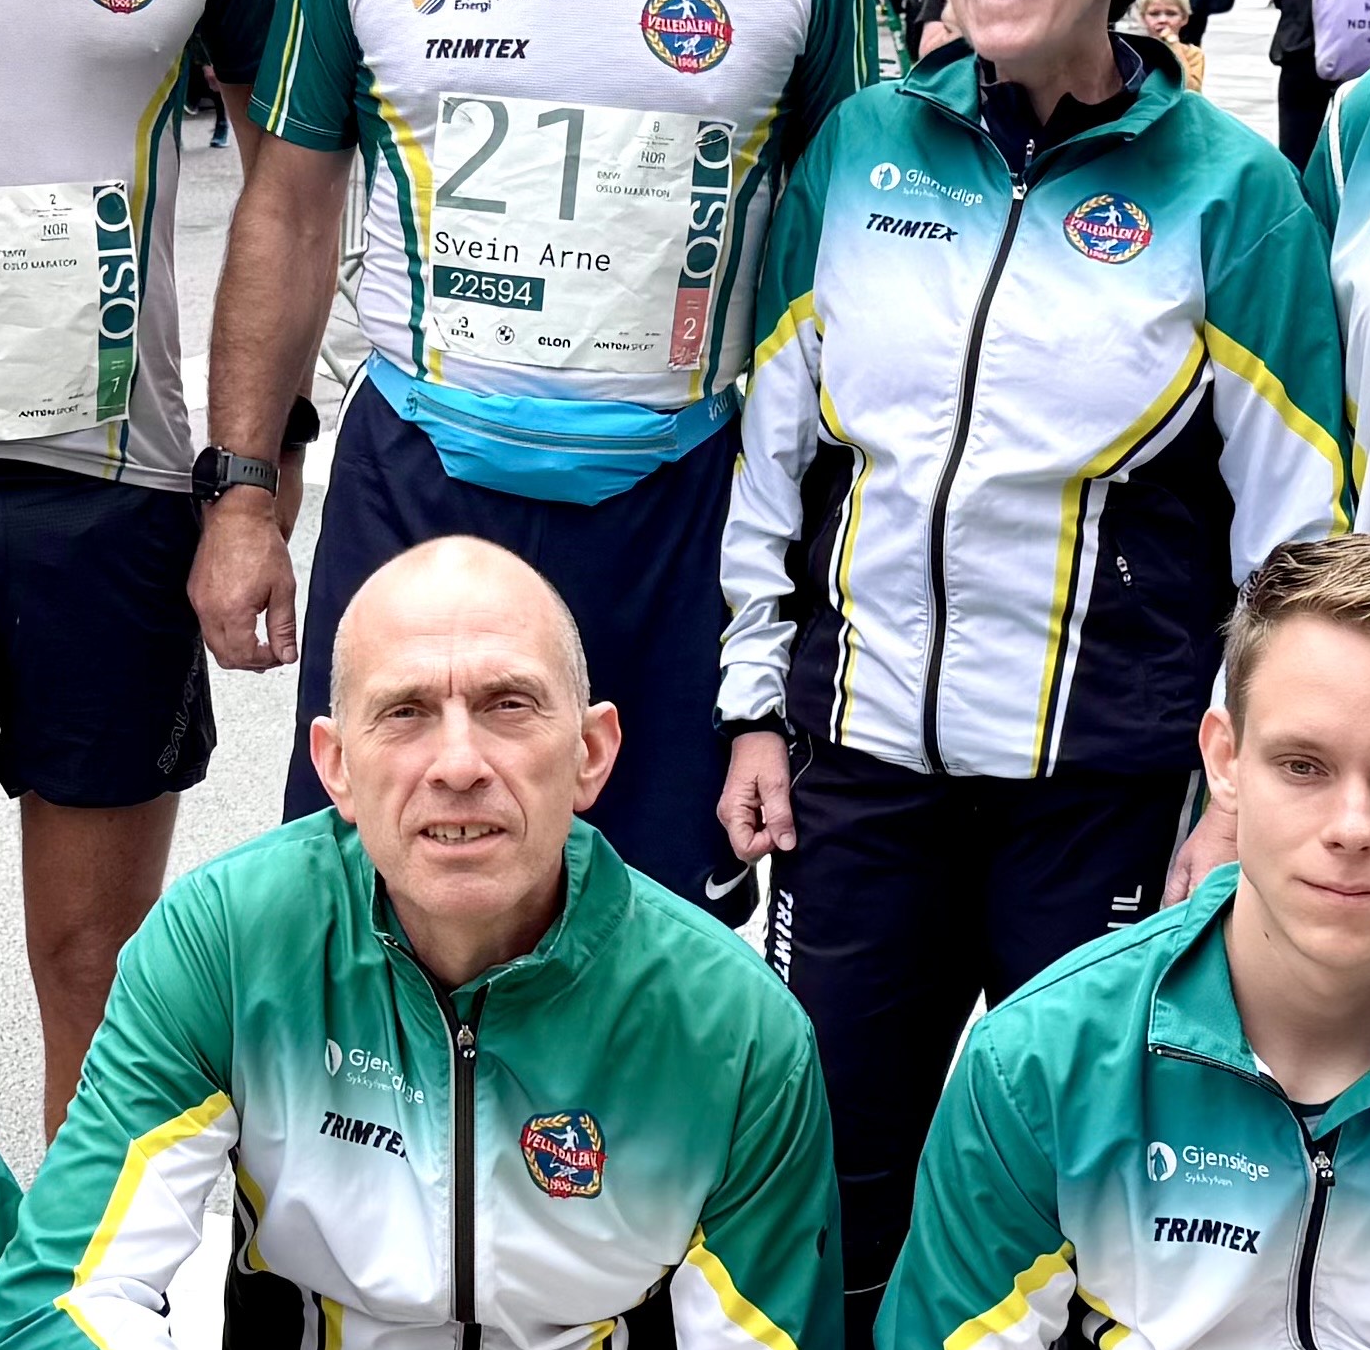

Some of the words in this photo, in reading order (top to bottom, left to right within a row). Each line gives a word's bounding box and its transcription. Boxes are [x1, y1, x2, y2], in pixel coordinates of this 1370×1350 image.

[454, 0, 492, 13] Energi
[647, 14, 714, 35] VELLEDALEN
[425, 39, 530, 60] TRIMTEX
[435, 96, 585, 221] 21
[682, 122, 734, 280] OSLO
[866, 212, 959, 243] TRIMTEX
[92, 186, 138, 340] OSLO
[435, 231, 519, 263] Svein
[539, 243, 611, 272] Arne
[449, 271, 533, 307] 22594
[683, 317, 696, 340] 2
[773, 889, 793, 989] TRIMT
[1153, 1217, 1261, 1255] TRIMTEX
